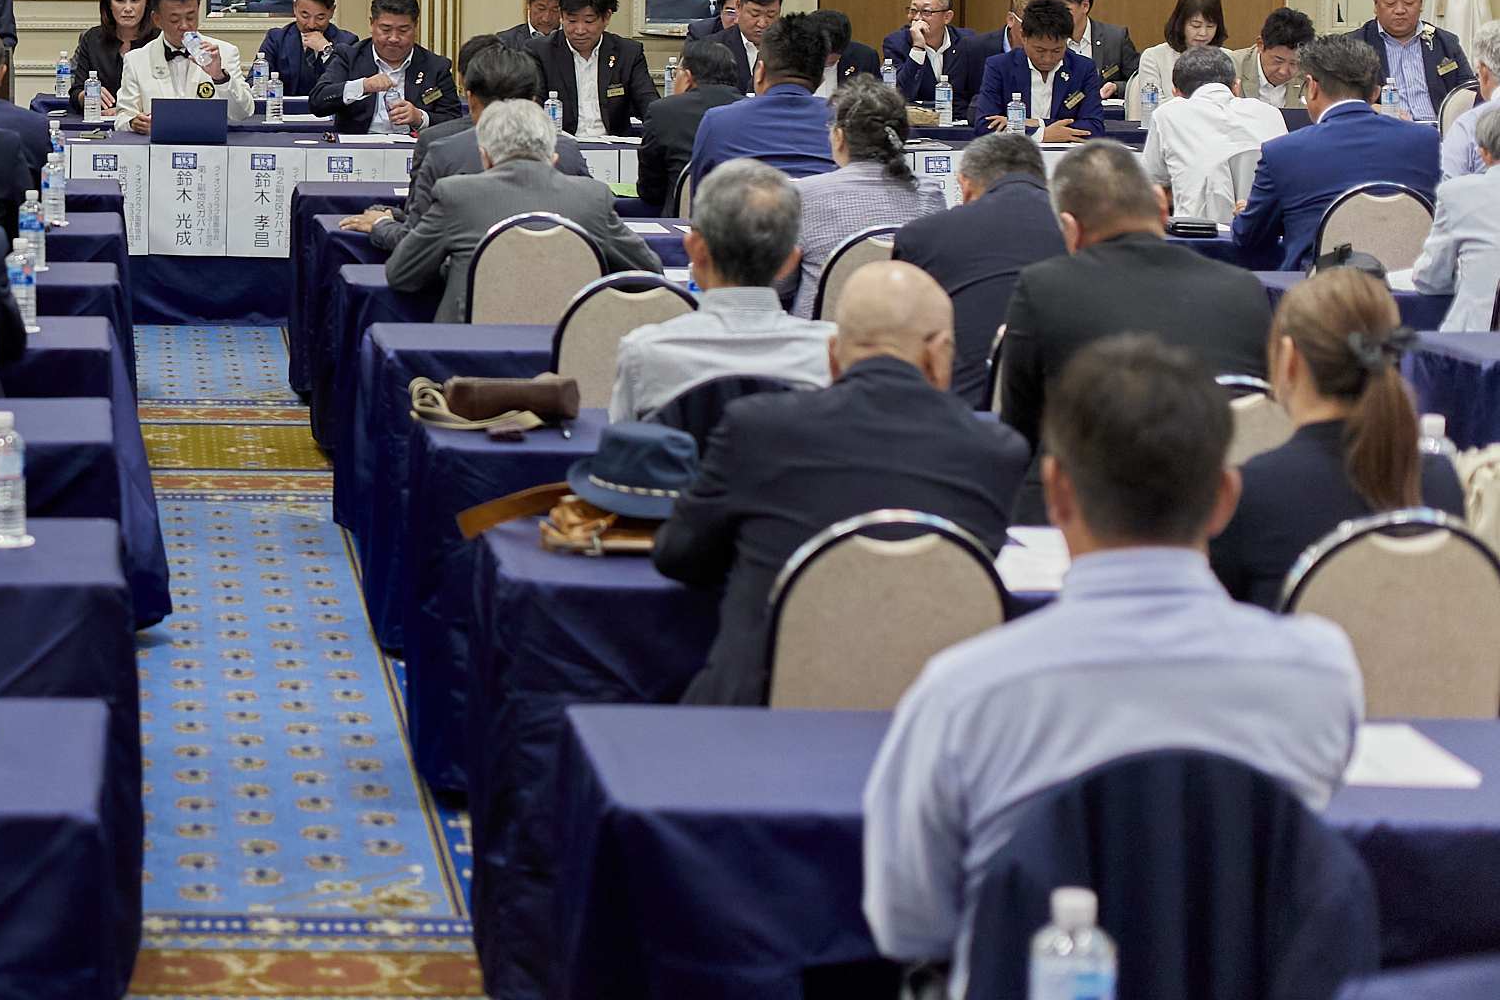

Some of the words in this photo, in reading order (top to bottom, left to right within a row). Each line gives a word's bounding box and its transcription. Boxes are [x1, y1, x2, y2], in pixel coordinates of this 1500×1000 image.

[176, 170, 193, 203] 鈴木
[254, 172, 271, 205] 鈴木
[176, 213, 192, 246] 光成
[254, 215, 270, 248] 孝昌
